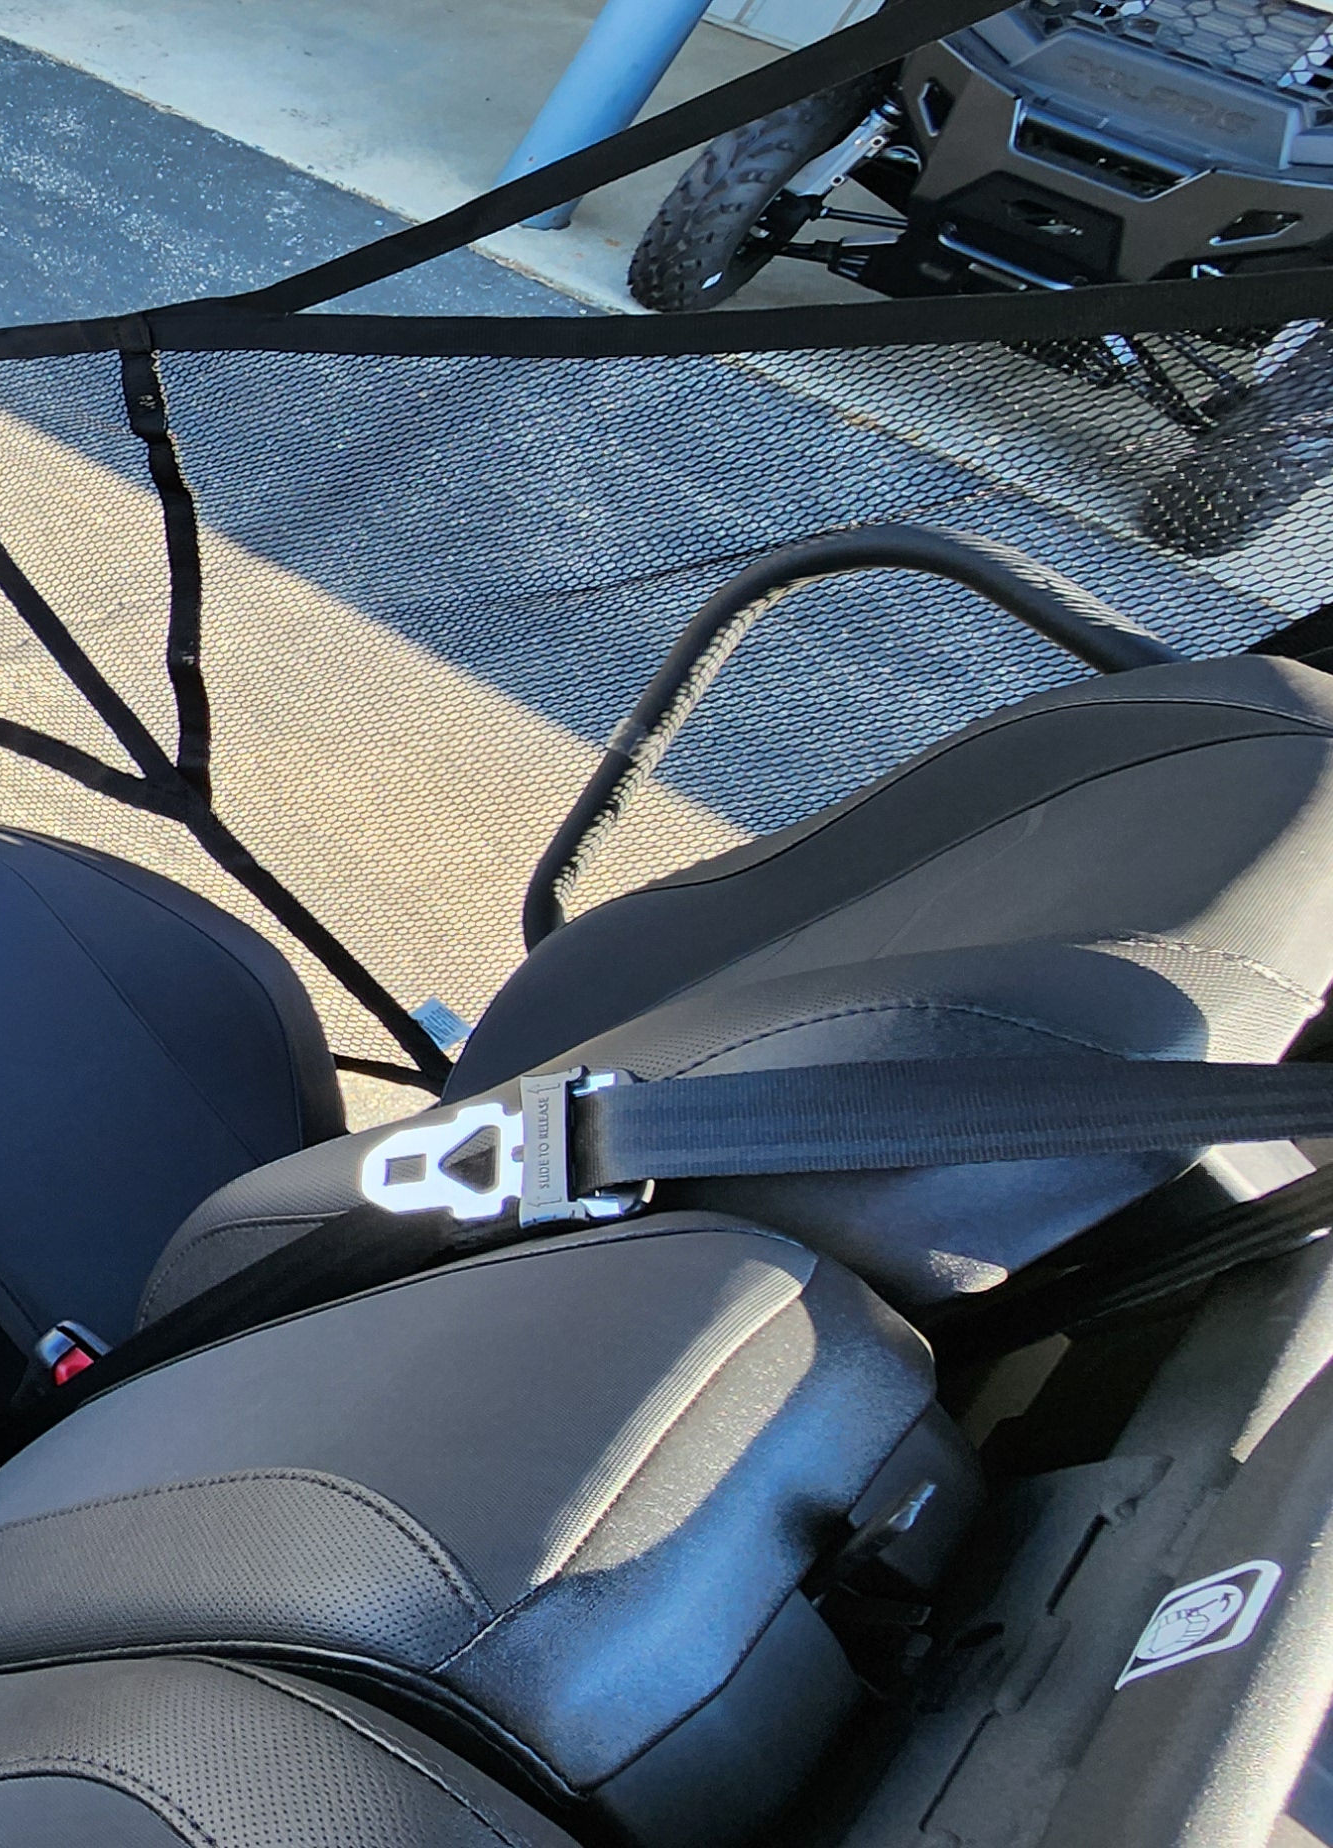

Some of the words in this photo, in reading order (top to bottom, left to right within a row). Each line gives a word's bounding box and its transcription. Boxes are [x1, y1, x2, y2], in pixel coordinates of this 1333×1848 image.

[538, 1096, 550, 1140] RELEASE
[538, 1142, 550, 1158] TO
[538, 1159, 551, 1190] SLIDE
